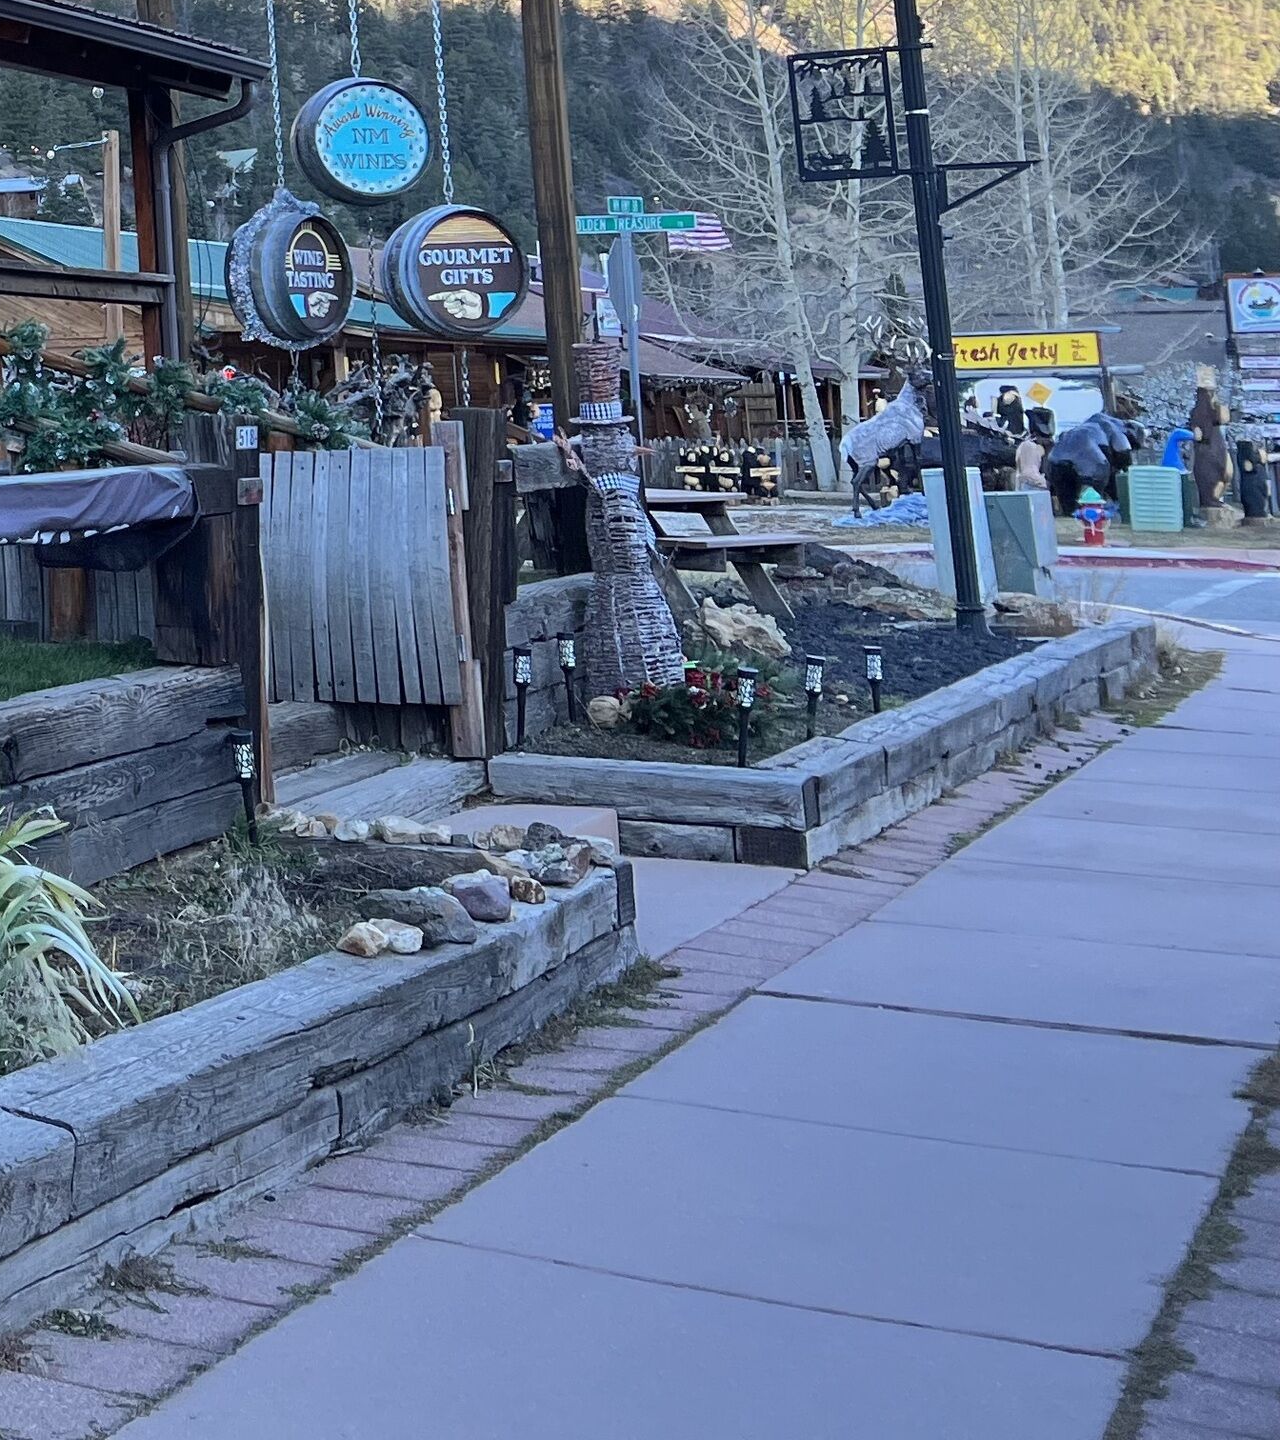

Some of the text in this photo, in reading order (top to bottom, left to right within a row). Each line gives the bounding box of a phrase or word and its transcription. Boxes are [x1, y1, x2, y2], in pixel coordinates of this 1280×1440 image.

[323, 103, 415, 138] Award Winning
[352, 128, 390, 144] NM
[336, 153, 407, 170] WINES
[576, 217, 607, 232] OLDEN
[614, 216, 662, 231] TREASURE
[293, 249, 324, 266] WINE
[419, 248, 513, 266] GOURMET
[286, 271, 335, 289] TASTING
[440, 268, 494, 285] GIFTS
[239, 428, 255, 447] 518
